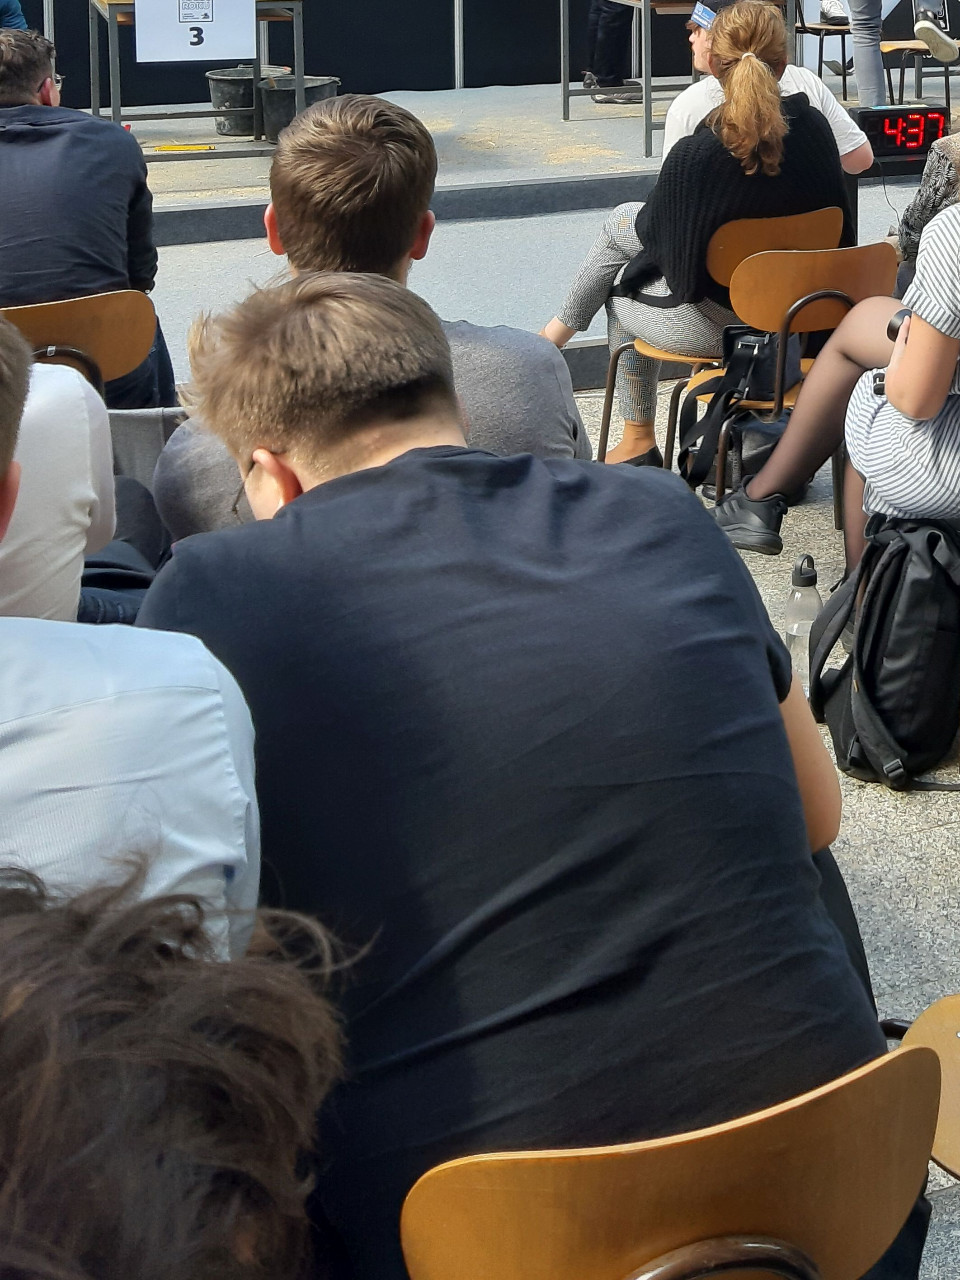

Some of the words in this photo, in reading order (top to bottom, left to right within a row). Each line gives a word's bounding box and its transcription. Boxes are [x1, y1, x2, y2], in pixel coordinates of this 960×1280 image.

[182, 1, 210, 10] ROKU
[189, 26, 205, 46] 3
[884, 112, 945, 148] 4:37
